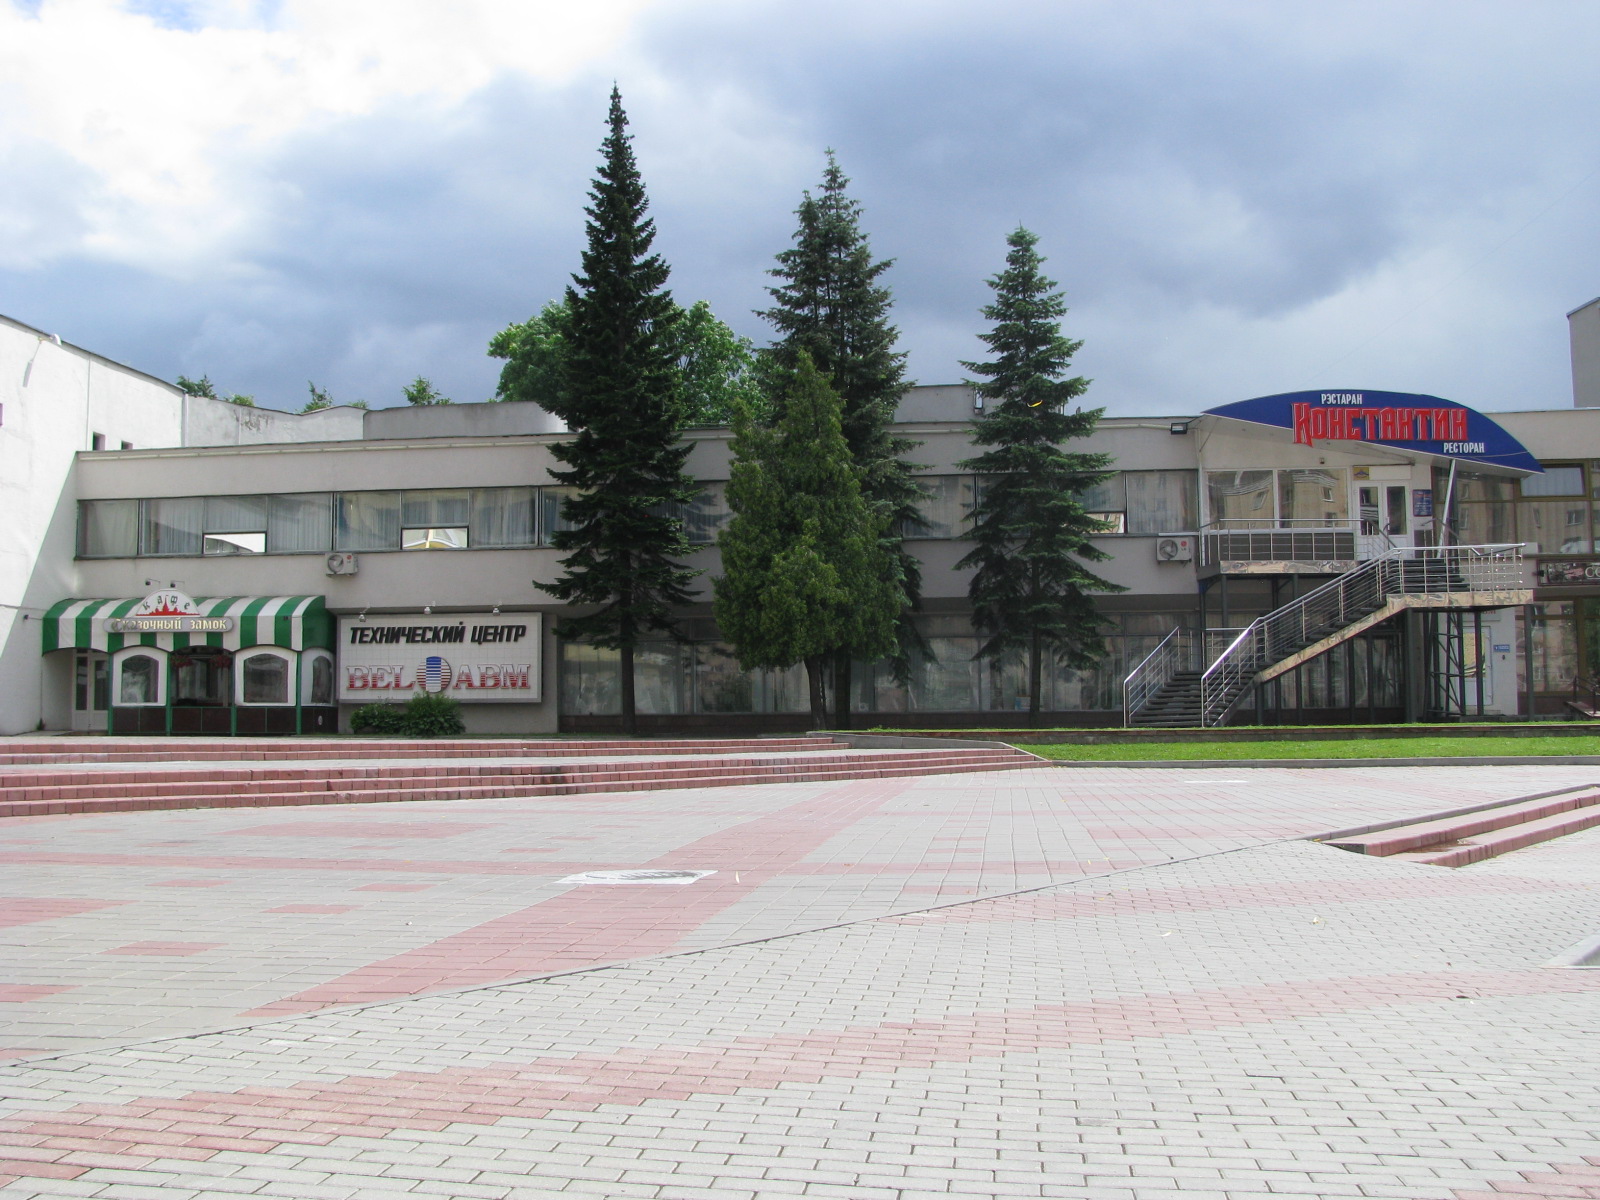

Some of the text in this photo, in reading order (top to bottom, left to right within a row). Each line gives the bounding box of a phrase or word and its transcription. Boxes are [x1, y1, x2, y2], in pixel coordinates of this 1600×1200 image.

[1321, 393, 1362, 405] РЭСТАРАН
[1443, 442, 1485, 455] РЕСТОРАН
[142, 595, 191, 611] кафе
[111, 618, 227, 632] Сказочный замок
[350, 621, 527, 645] ТЕХНИЧЕСКИЙ ЦЕНТР
[346, 663, 531, 690] BEL ABM
